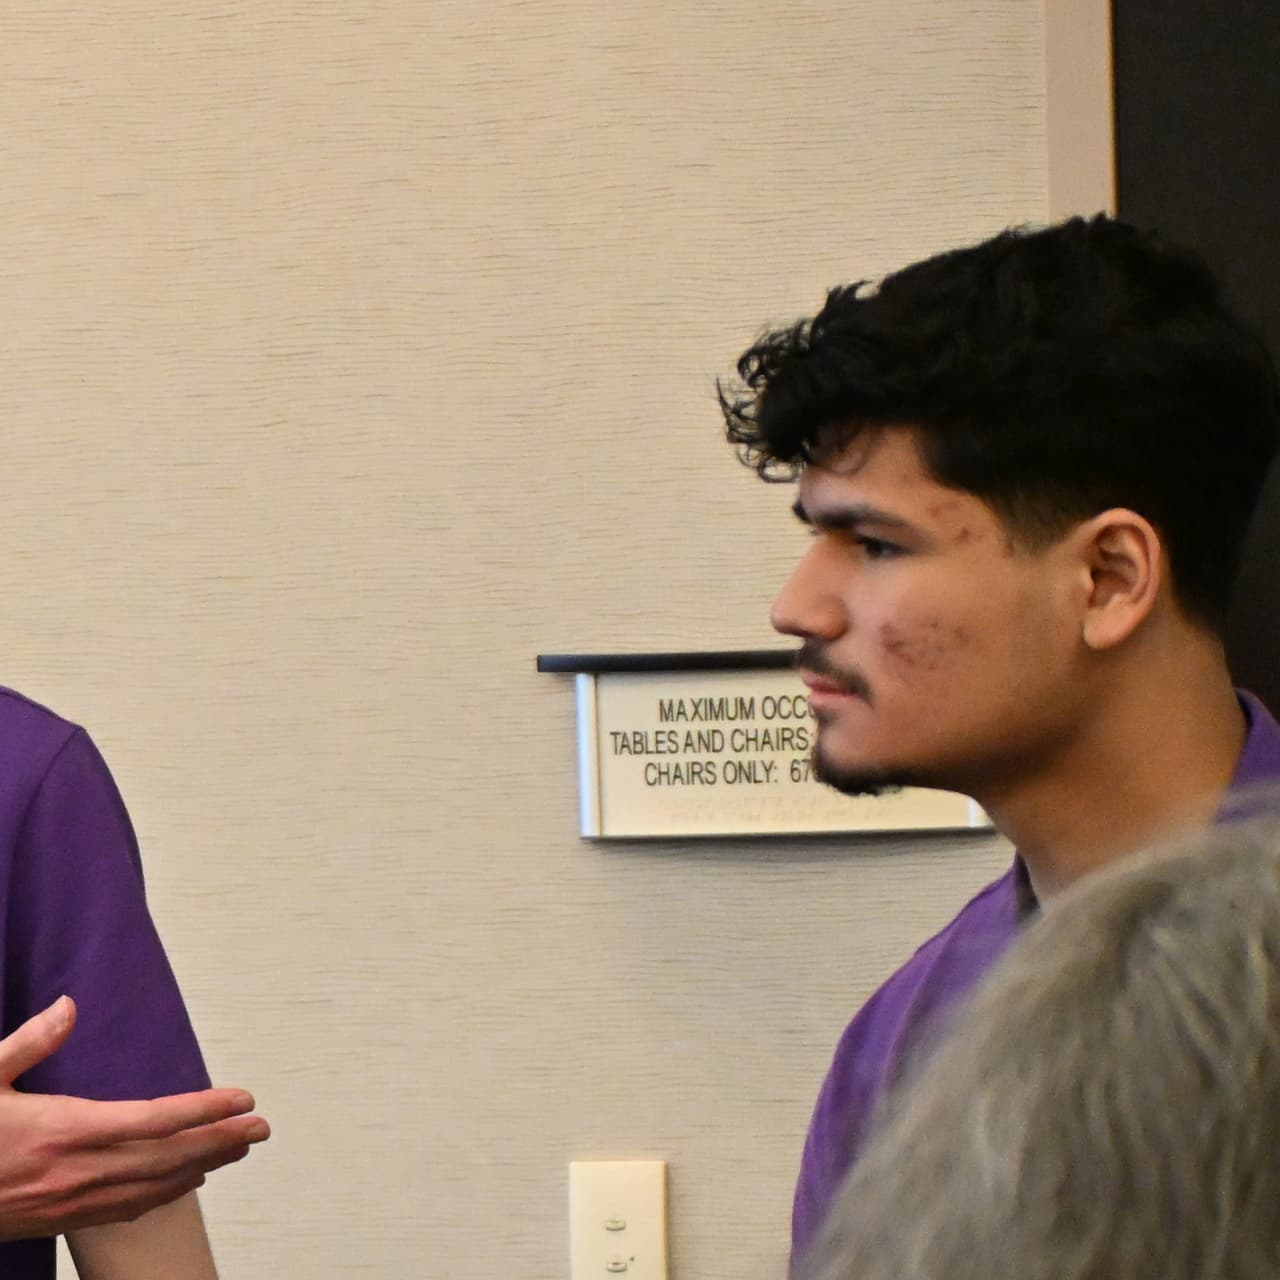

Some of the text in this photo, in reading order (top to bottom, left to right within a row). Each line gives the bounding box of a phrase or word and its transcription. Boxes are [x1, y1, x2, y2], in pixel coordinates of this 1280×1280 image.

[658, 696, 756, 723] MAXIMUM
[609, 730, 679, 756] TABLES
[683, 728, 725, 754] AND
[644, 761, 717, 787] CHAIRS
[722, 759, 778, 785] ONLY:
